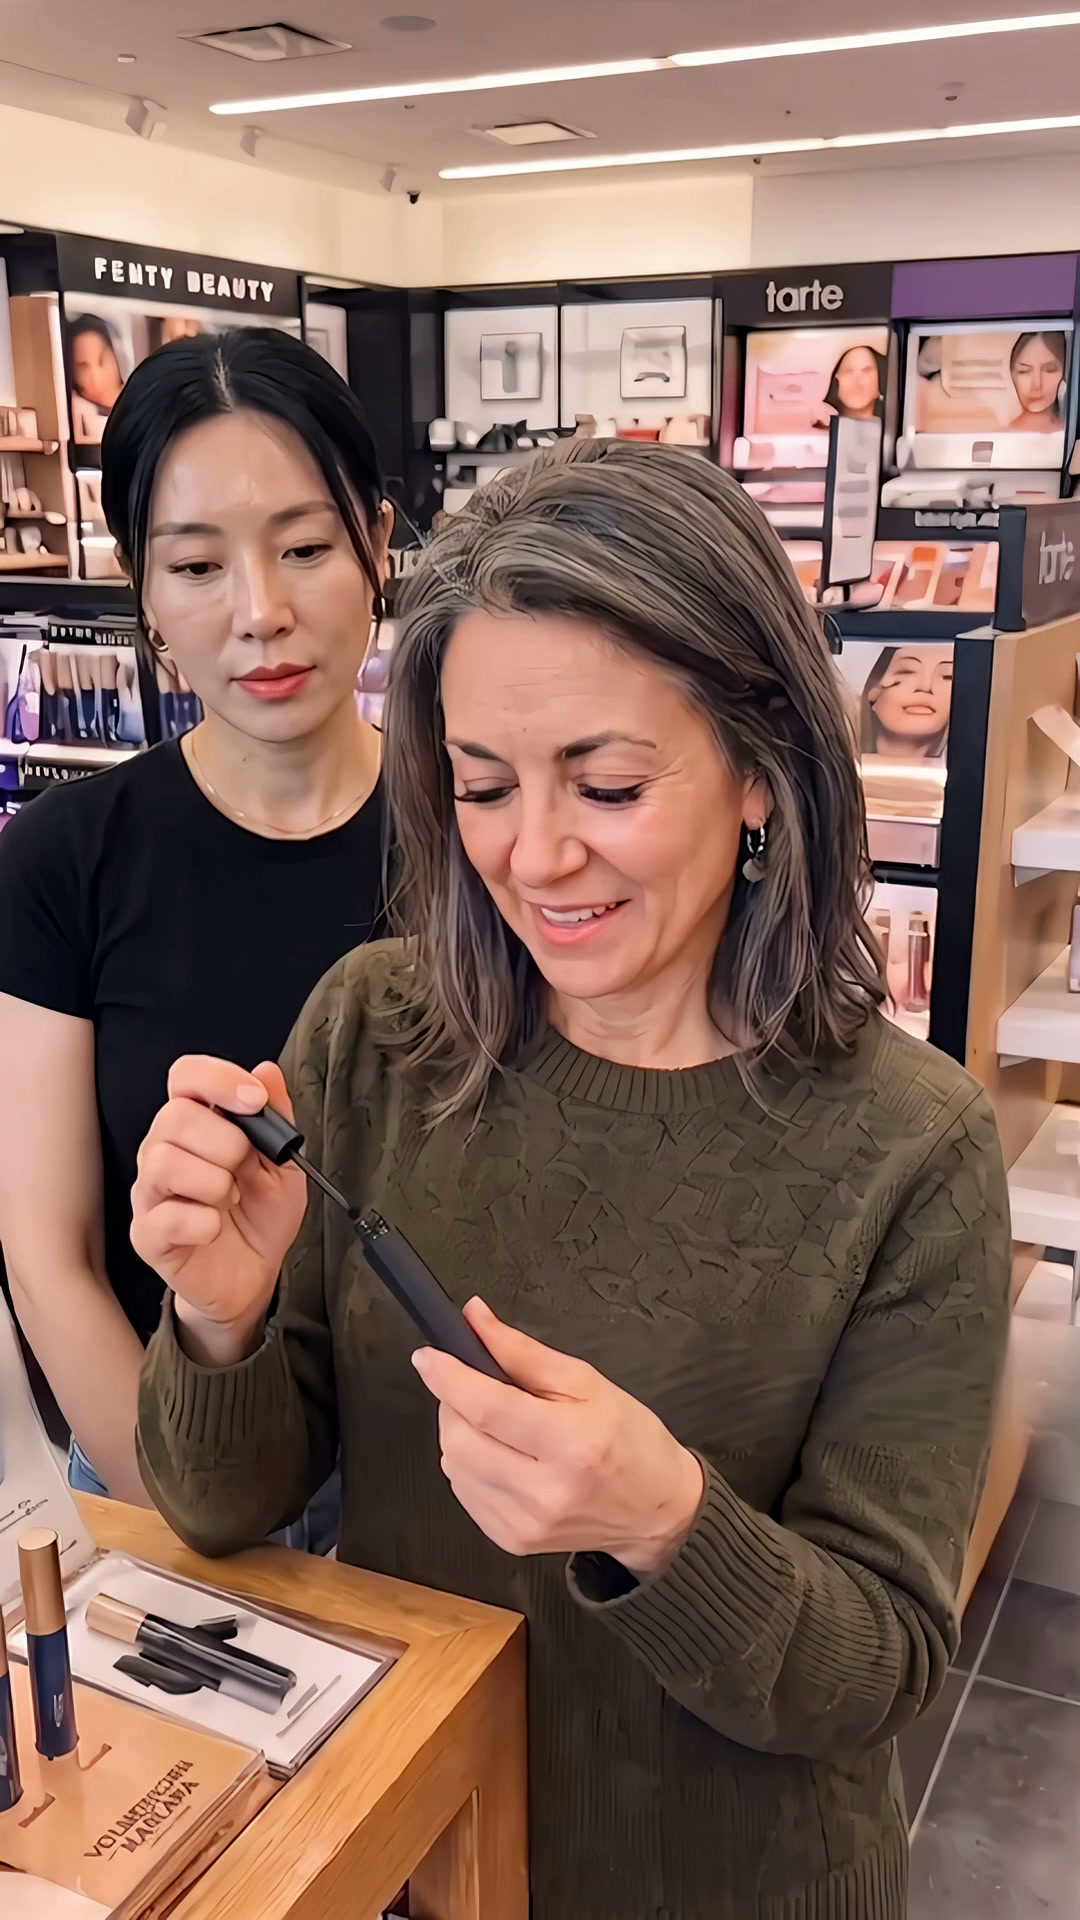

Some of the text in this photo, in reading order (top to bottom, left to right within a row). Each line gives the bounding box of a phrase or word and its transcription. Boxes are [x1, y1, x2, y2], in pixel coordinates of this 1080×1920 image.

[94, 257, 274, 303] FENTY BEAUTY
[765, 279, 844, 313] tarte
